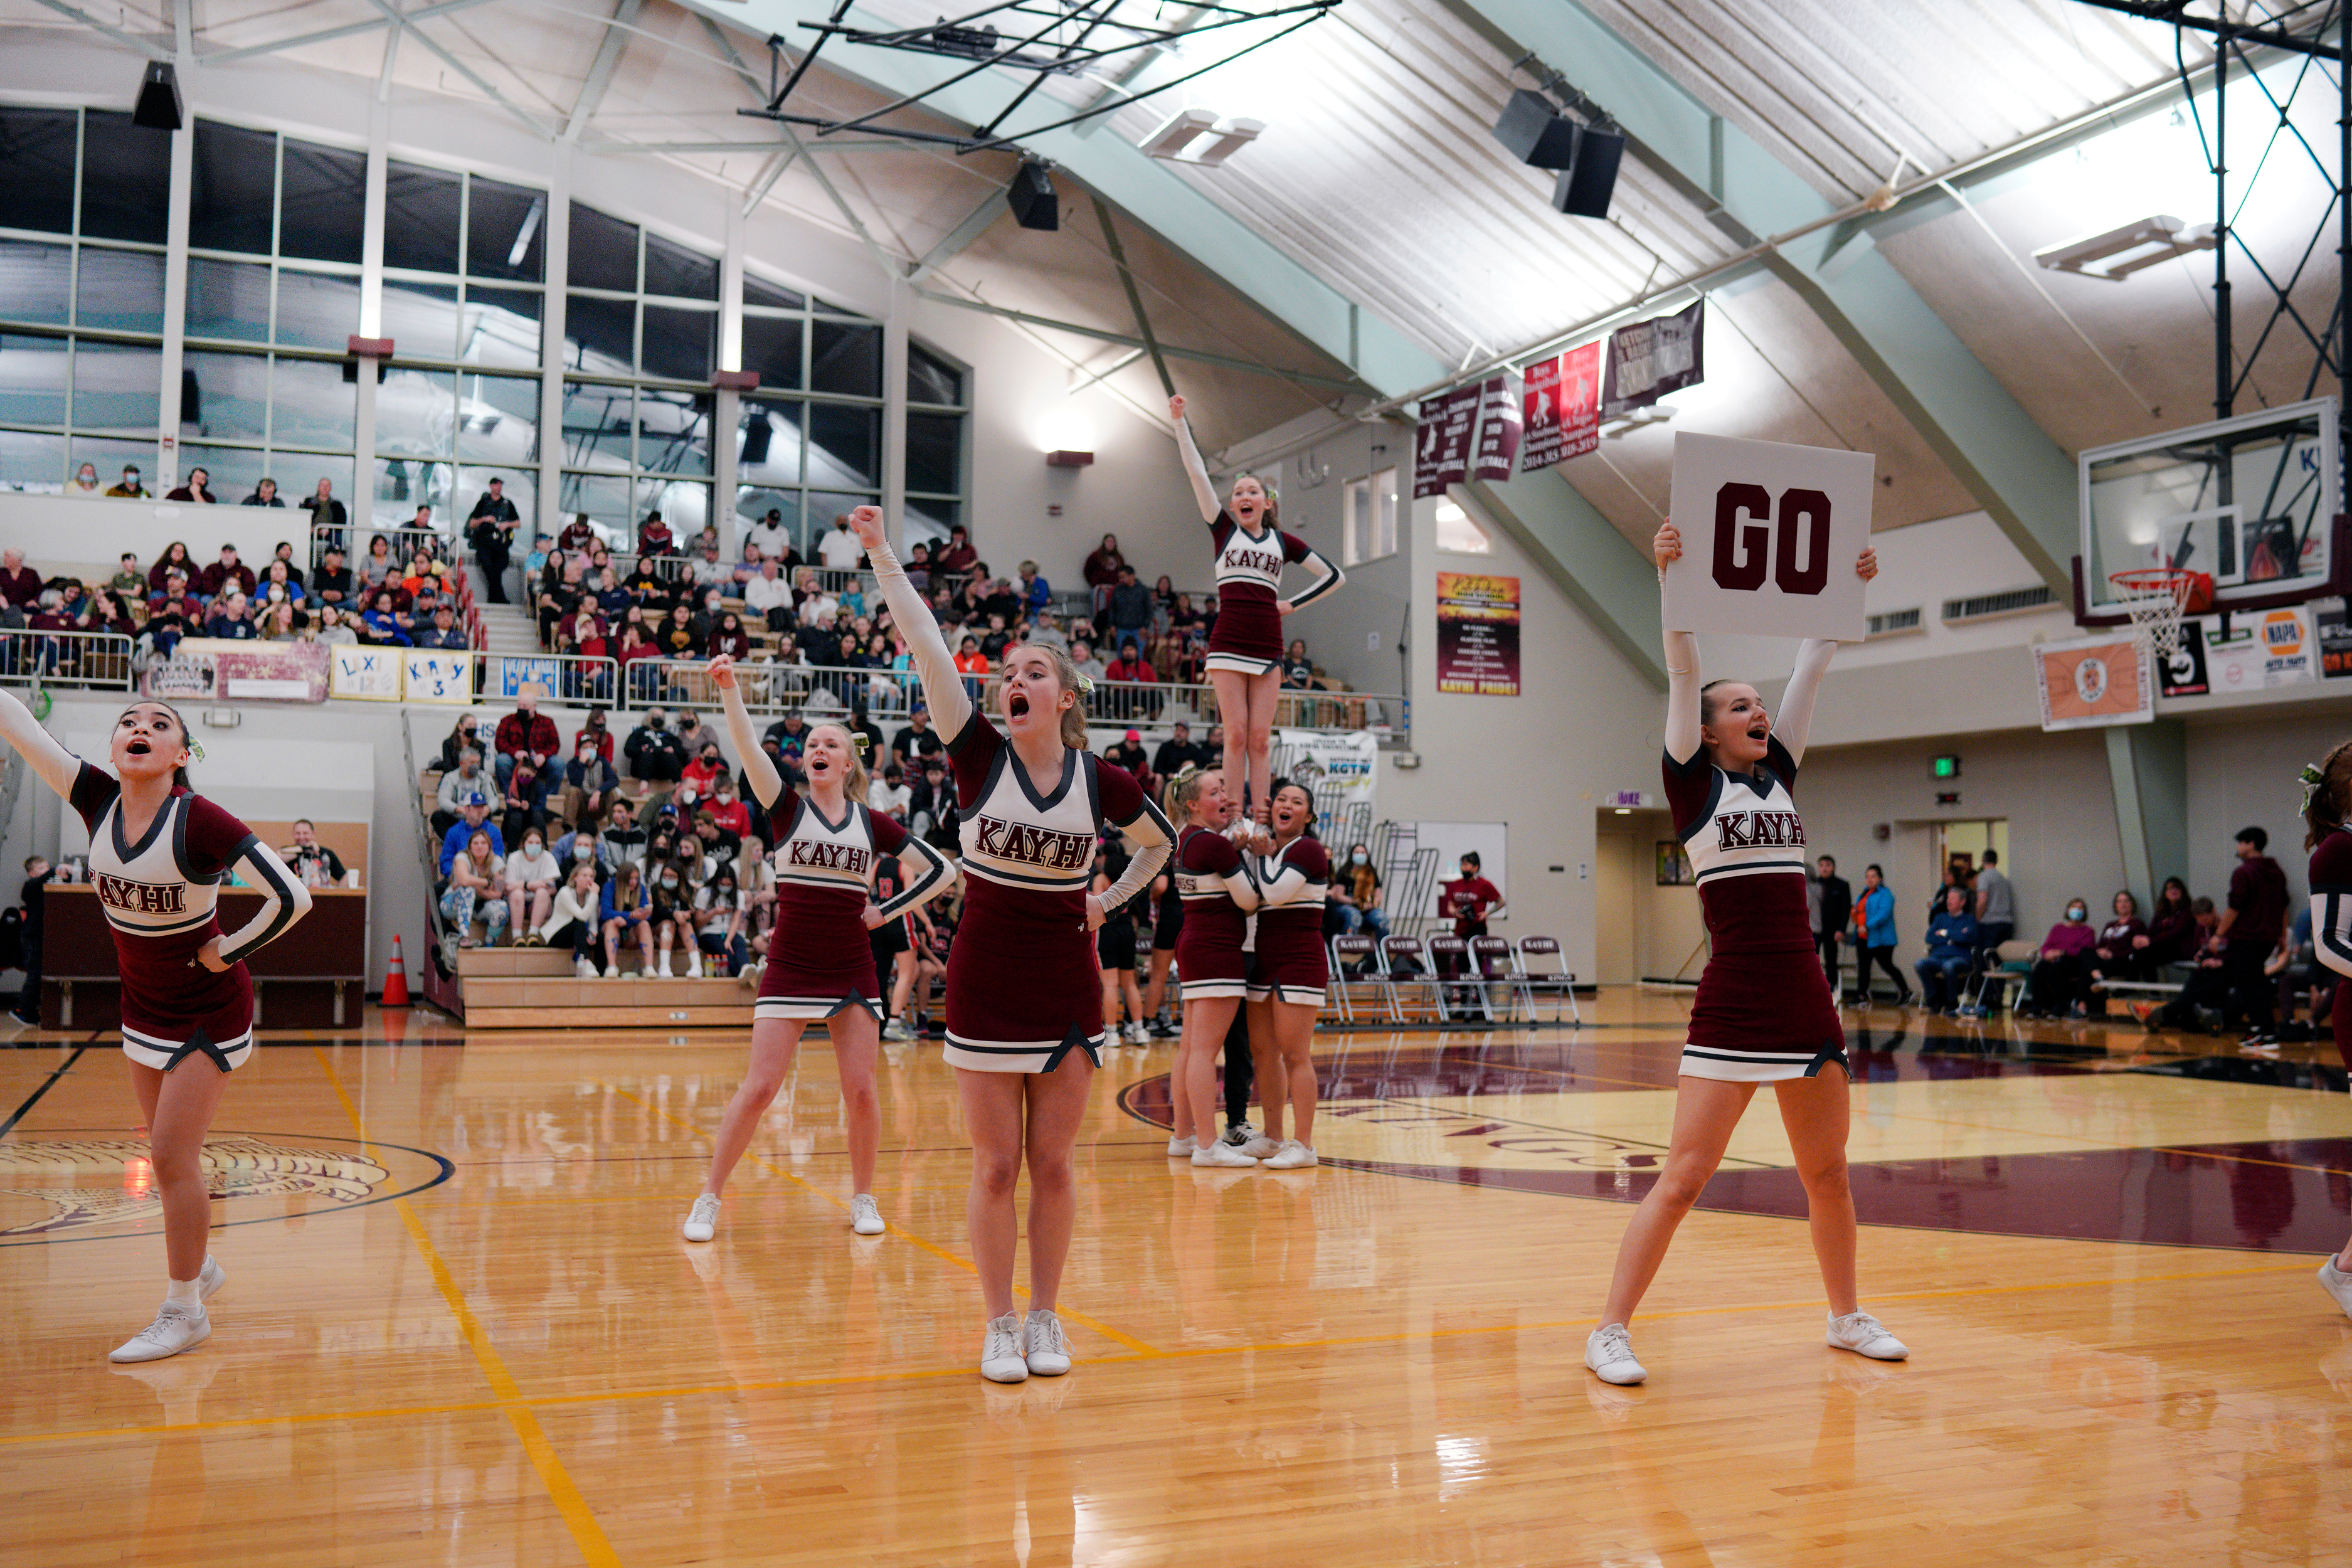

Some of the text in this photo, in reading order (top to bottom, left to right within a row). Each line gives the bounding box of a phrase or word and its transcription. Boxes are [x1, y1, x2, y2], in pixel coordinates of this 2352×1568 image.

[1712, 482, 1831, 595] GO
[1224, 549, 1282, 578] KAYHI
[2267, 623, 2299, 644] NAPA
[975, 813, 1095, 871] KAYHI
[1714, 810, 1806, 852] KAYH
[789, 839, 872, 876] KAYHI
[89, 869, 186, 914] AYHI
